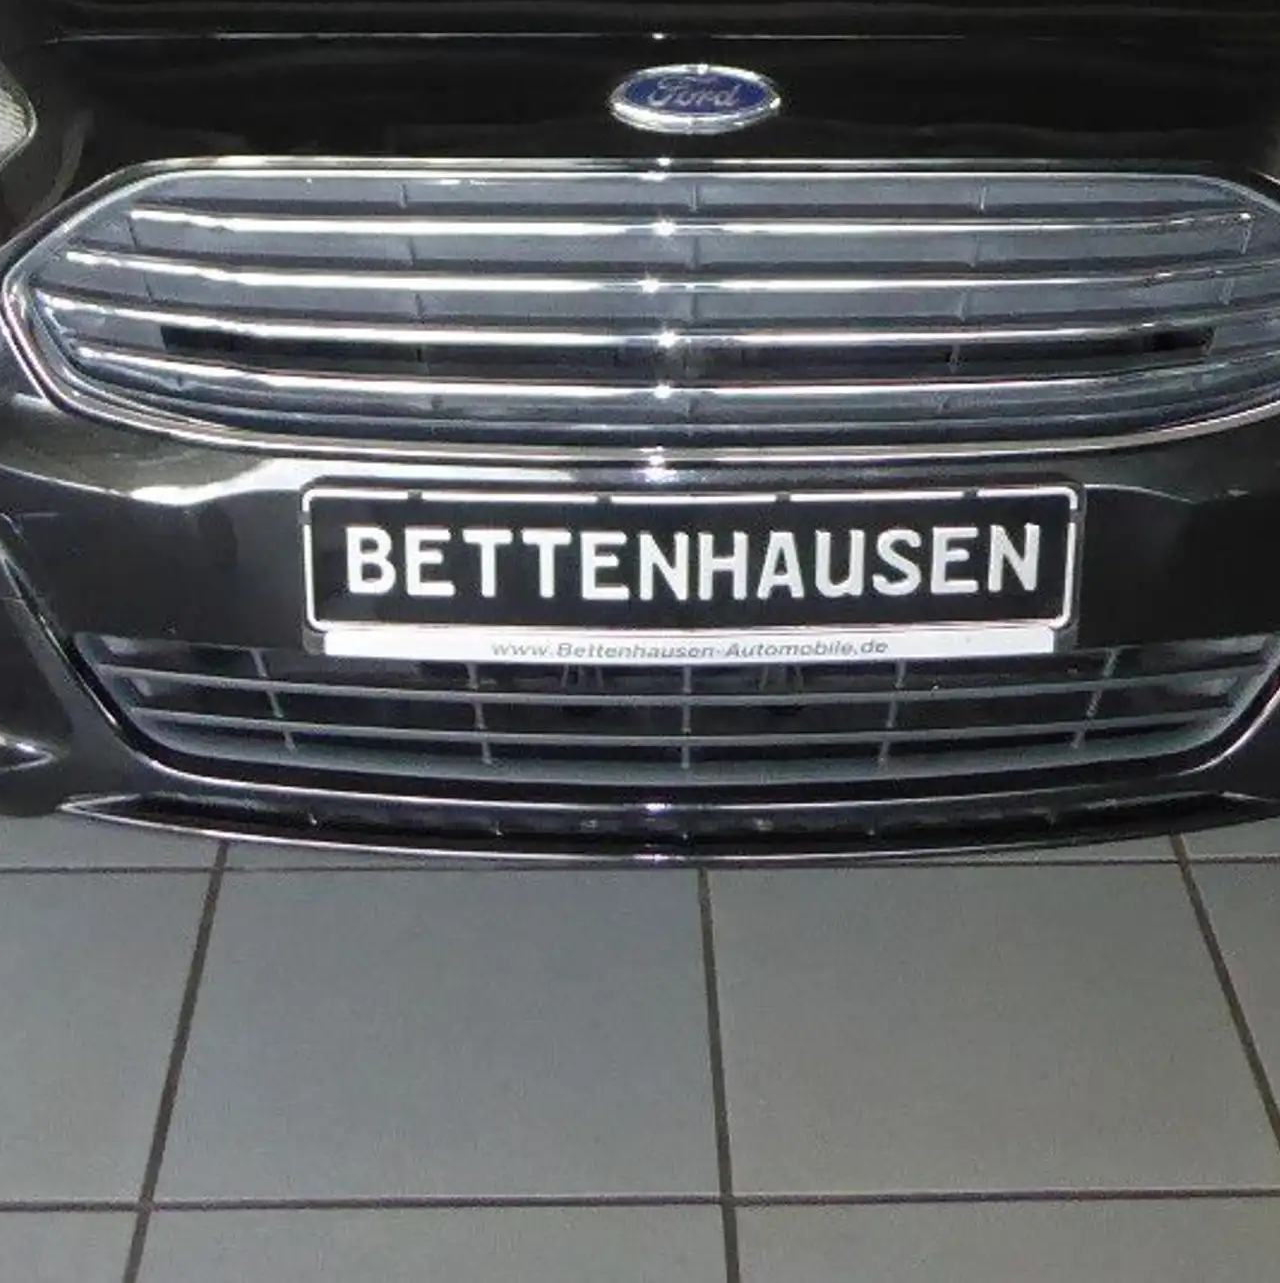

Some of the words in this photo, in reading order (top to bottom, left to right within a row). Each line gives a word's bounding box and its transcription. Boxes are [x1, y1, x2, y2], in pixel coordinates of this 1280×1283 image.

[646, 76, 740, 107] Ford
[345, 523, 1041, 601] BETTENHAUSEN
[491, 639, 889, 659] www.Bettenhausen-Automobile.de
